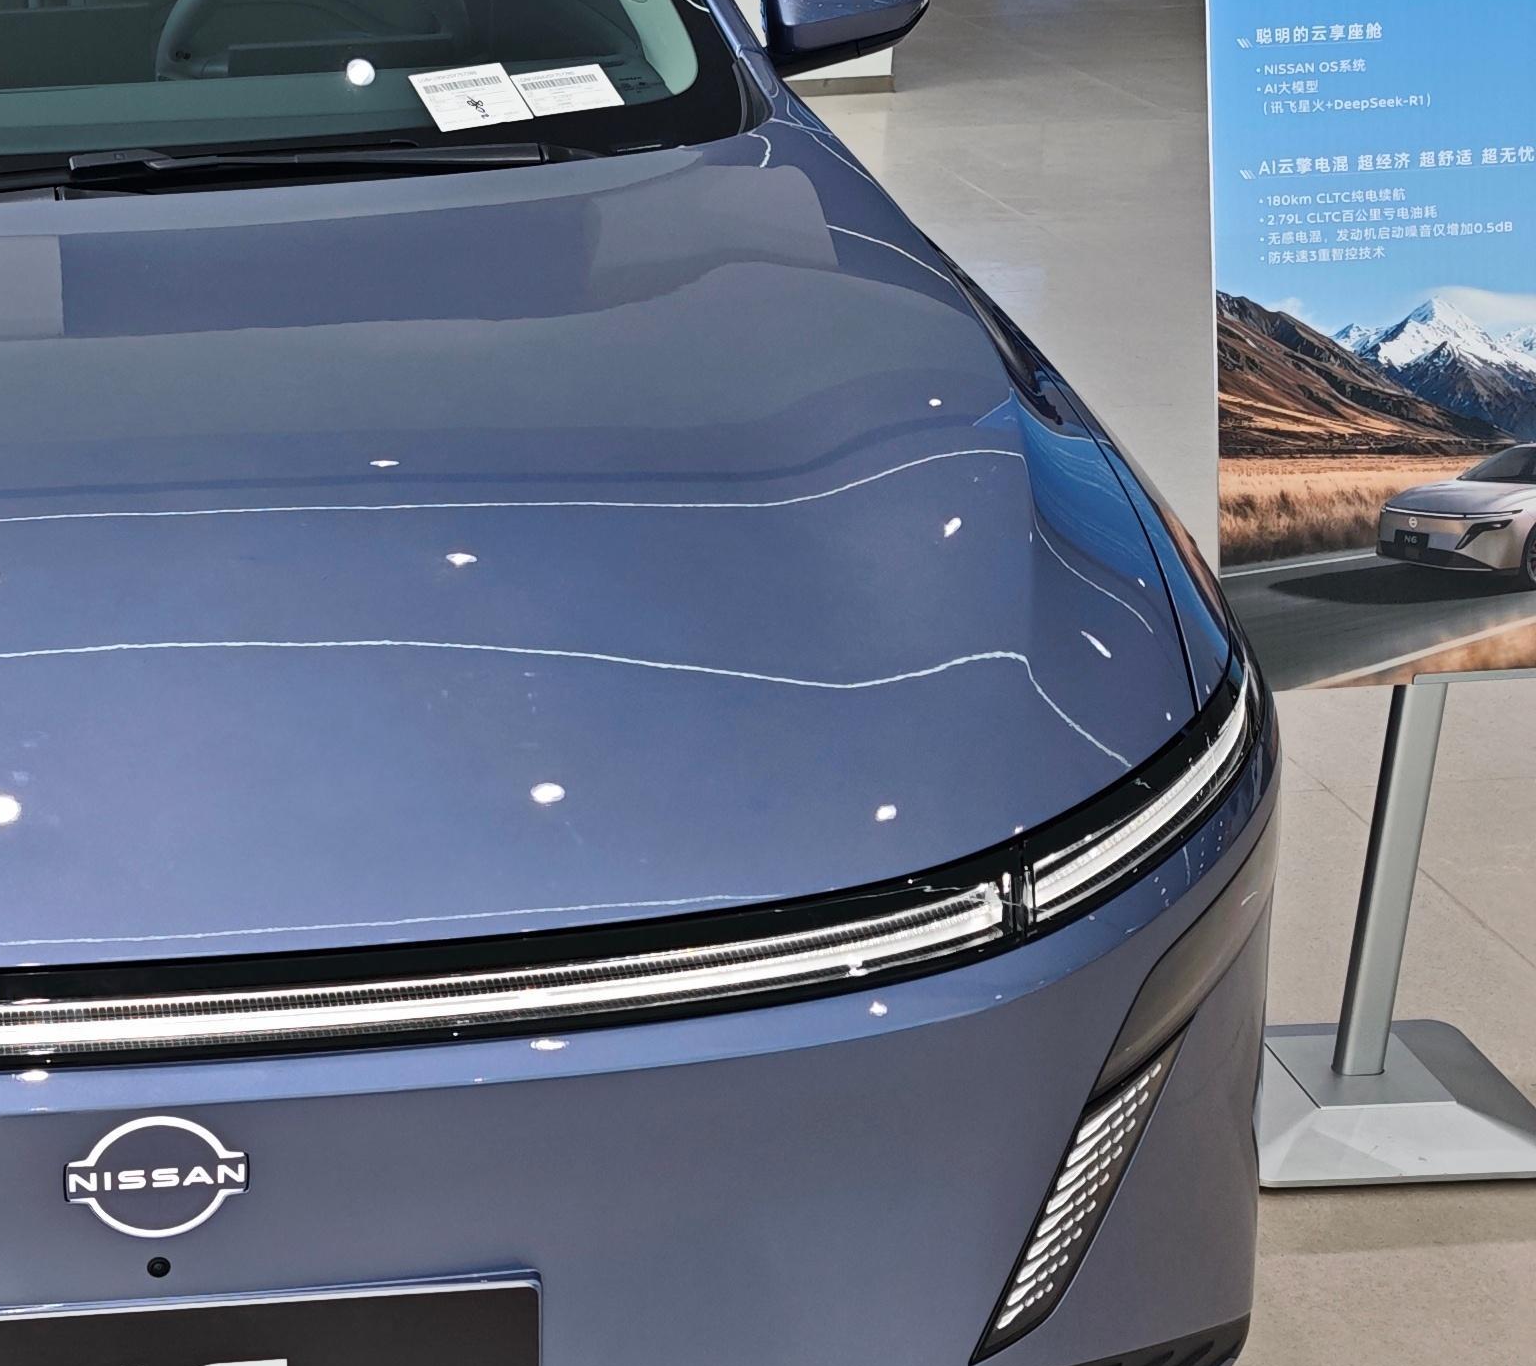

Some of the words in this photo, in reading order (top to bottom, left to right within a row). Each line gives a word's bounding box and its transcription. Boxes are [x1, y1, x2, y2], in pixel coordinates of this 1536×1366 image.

[1255, 22, 1383, 45] 聪明的云享座舱
[1264, 63, 1315, 75] NISSAN
[1319, 58, 1366, 73] OS系统
[1264, 80, 1319, 95] AI大模型
[1258, 156, 1349, 176] AI云擎电混
[1357, 152, 1410, 172] 超经济
[1419, 149, 1473, 168] 超舒适
[1481, 145, 1535, 165] 超无忧
[1267, 194, 1312, 207] 180km
[1316, 187, 1407, 204] CLTC纯电续航
[1307, 205, 1438, 225] CLTC百公里亏电油耗
[1268, 245, 1386, 265] 防失速3重智控技术
[69, 1163, 245, 1193] NISSAN
